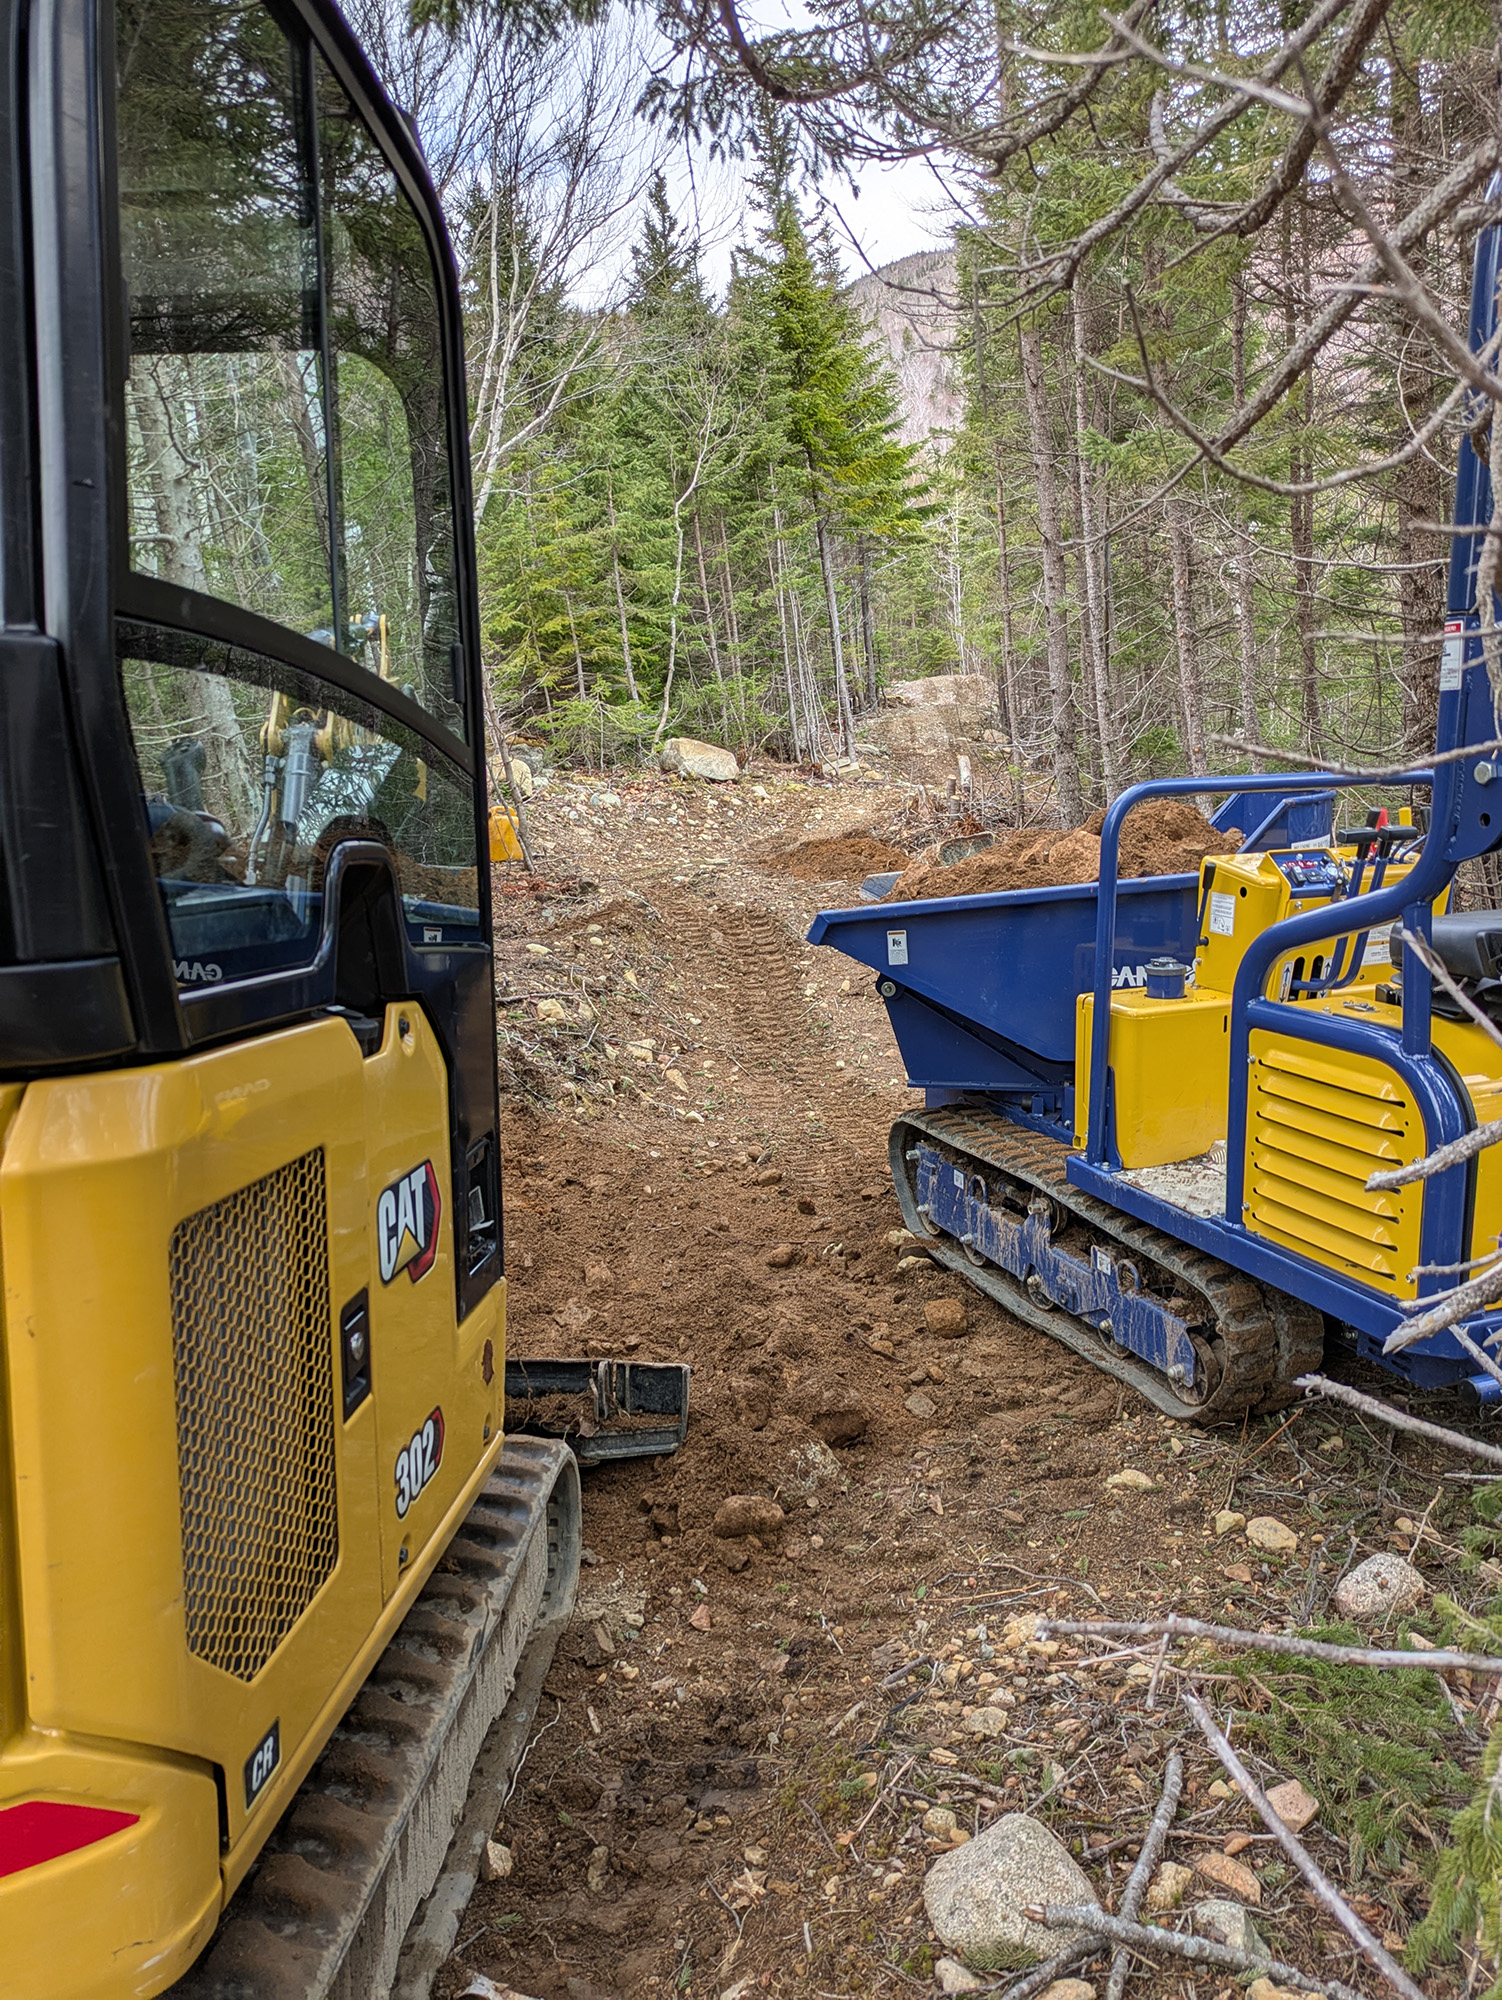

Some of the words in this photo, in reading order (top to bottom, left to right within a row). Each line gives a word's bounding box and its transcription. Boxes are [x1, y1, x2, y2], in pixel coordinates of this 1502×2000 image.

[378, 1164, 427, 1281] CAT
[395, 1419, 435, 1515] 302
[251, 1735, 274, 1792] CR
